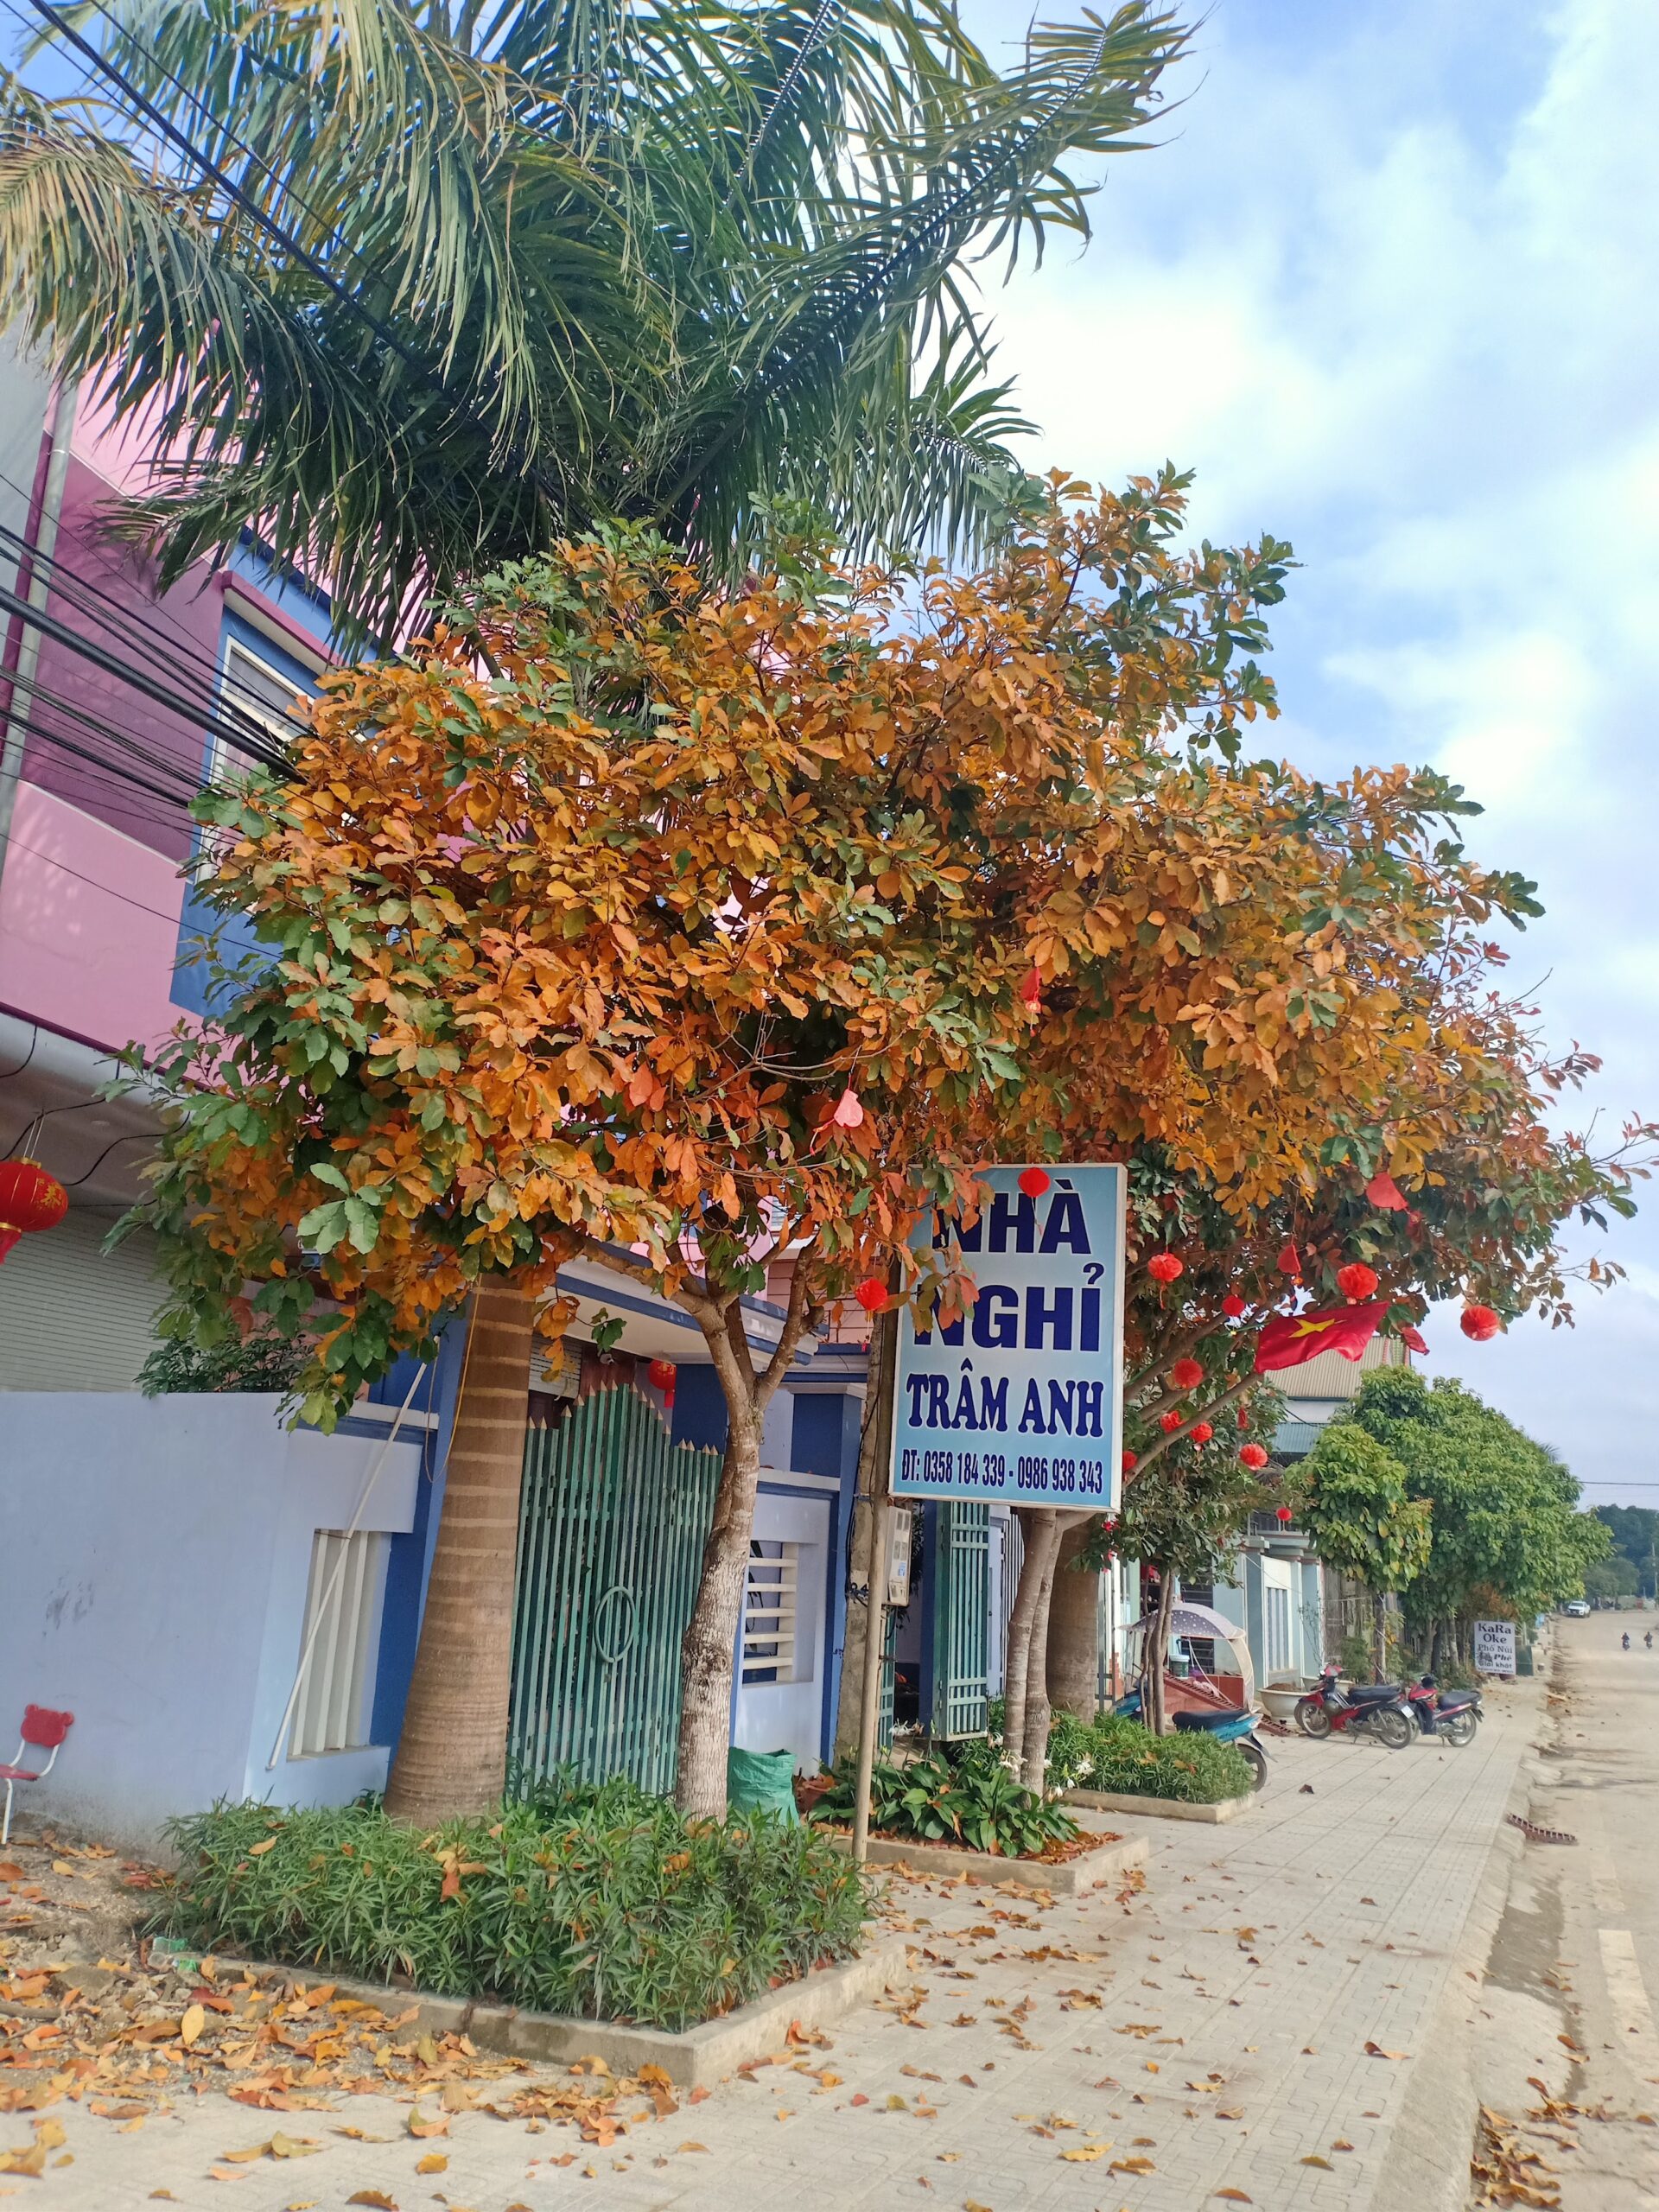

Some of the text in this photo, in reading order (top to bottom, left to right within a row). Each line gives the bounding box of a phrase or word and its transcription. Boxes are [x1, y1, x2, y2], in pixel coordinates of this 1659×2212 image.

[906, 1357, 1104, 1438] TRÂM ANH
[901, 1449, 920, 1481] ĐT:
[924, 1451, 953, 1484] 0358
[957, 1453, 979, 1485] 184
[982, 1454, 1005, 1487] 339
[1018, 1458, 1048, 1491] 0986
[1052, 1459, 1075, 1492] 938
[1079, 1460, 1103, 1495] 343
[1478, 1623, 1511, 1634] KaRa
[1483, 1633, 1507, 1643] Oke
